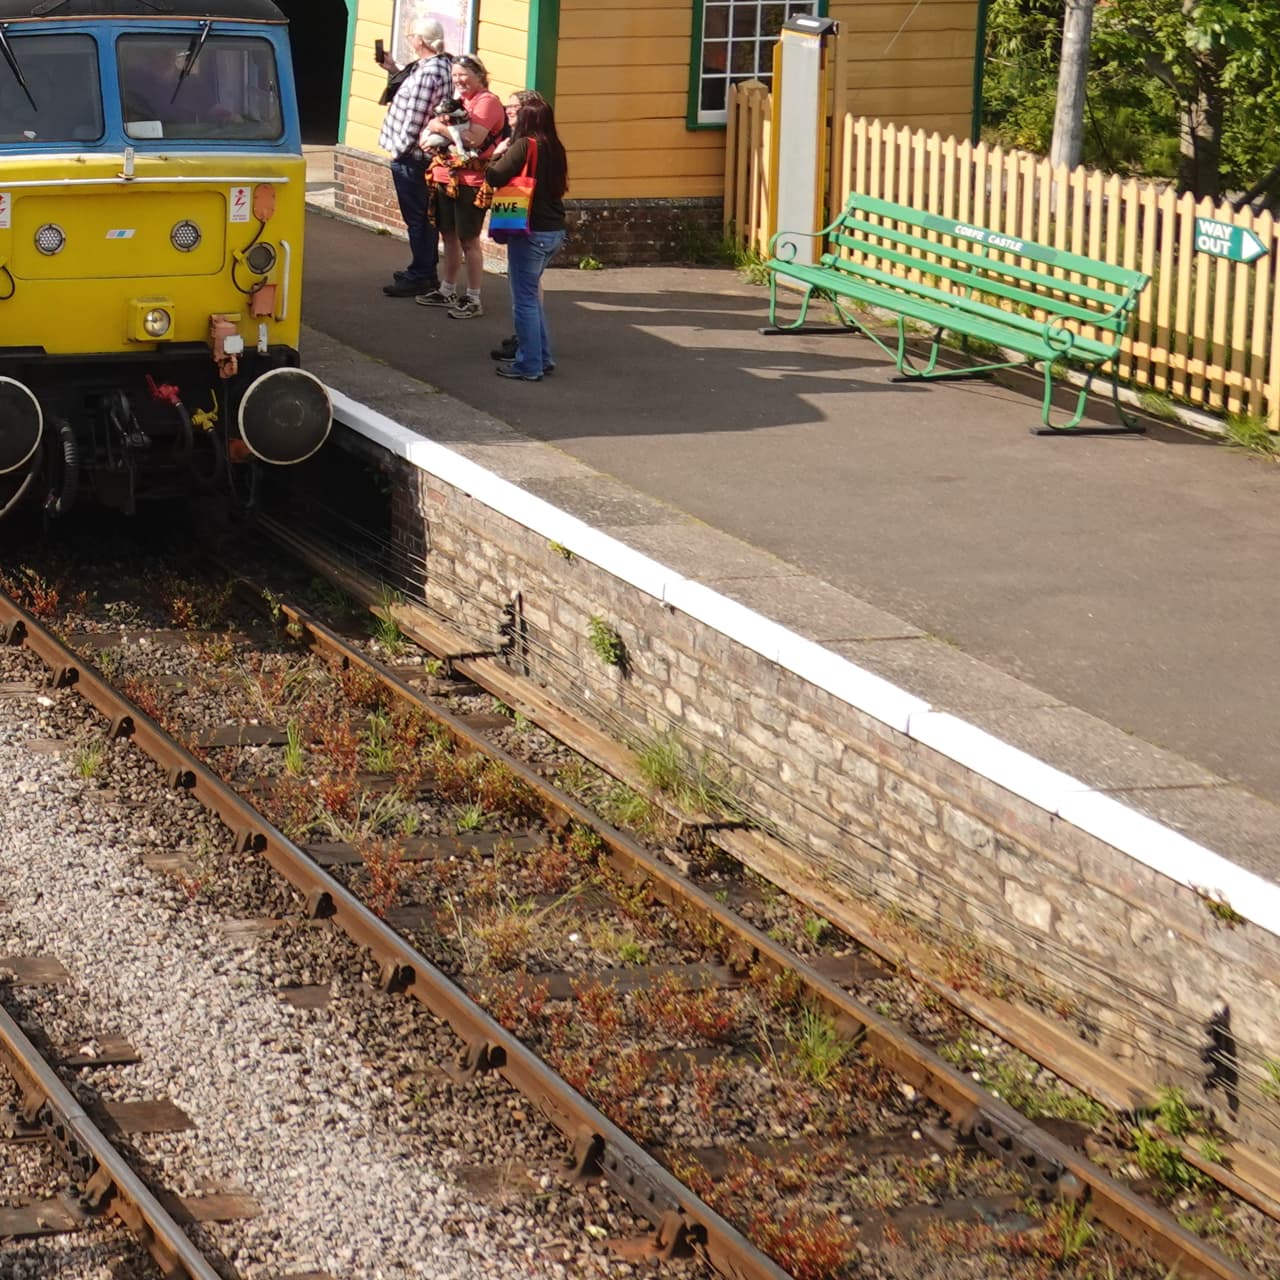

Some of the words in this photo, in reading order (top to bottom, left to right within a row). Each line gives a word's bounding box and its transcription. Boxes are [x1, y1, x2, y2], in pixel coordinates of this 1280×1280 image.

[954, 224, 985, 241] CORFE
[988, 234, 1024, 252] CASTLE
[1198, 219, 1233, 240] WAY
[1198, 235, 1232, 256] OUT
